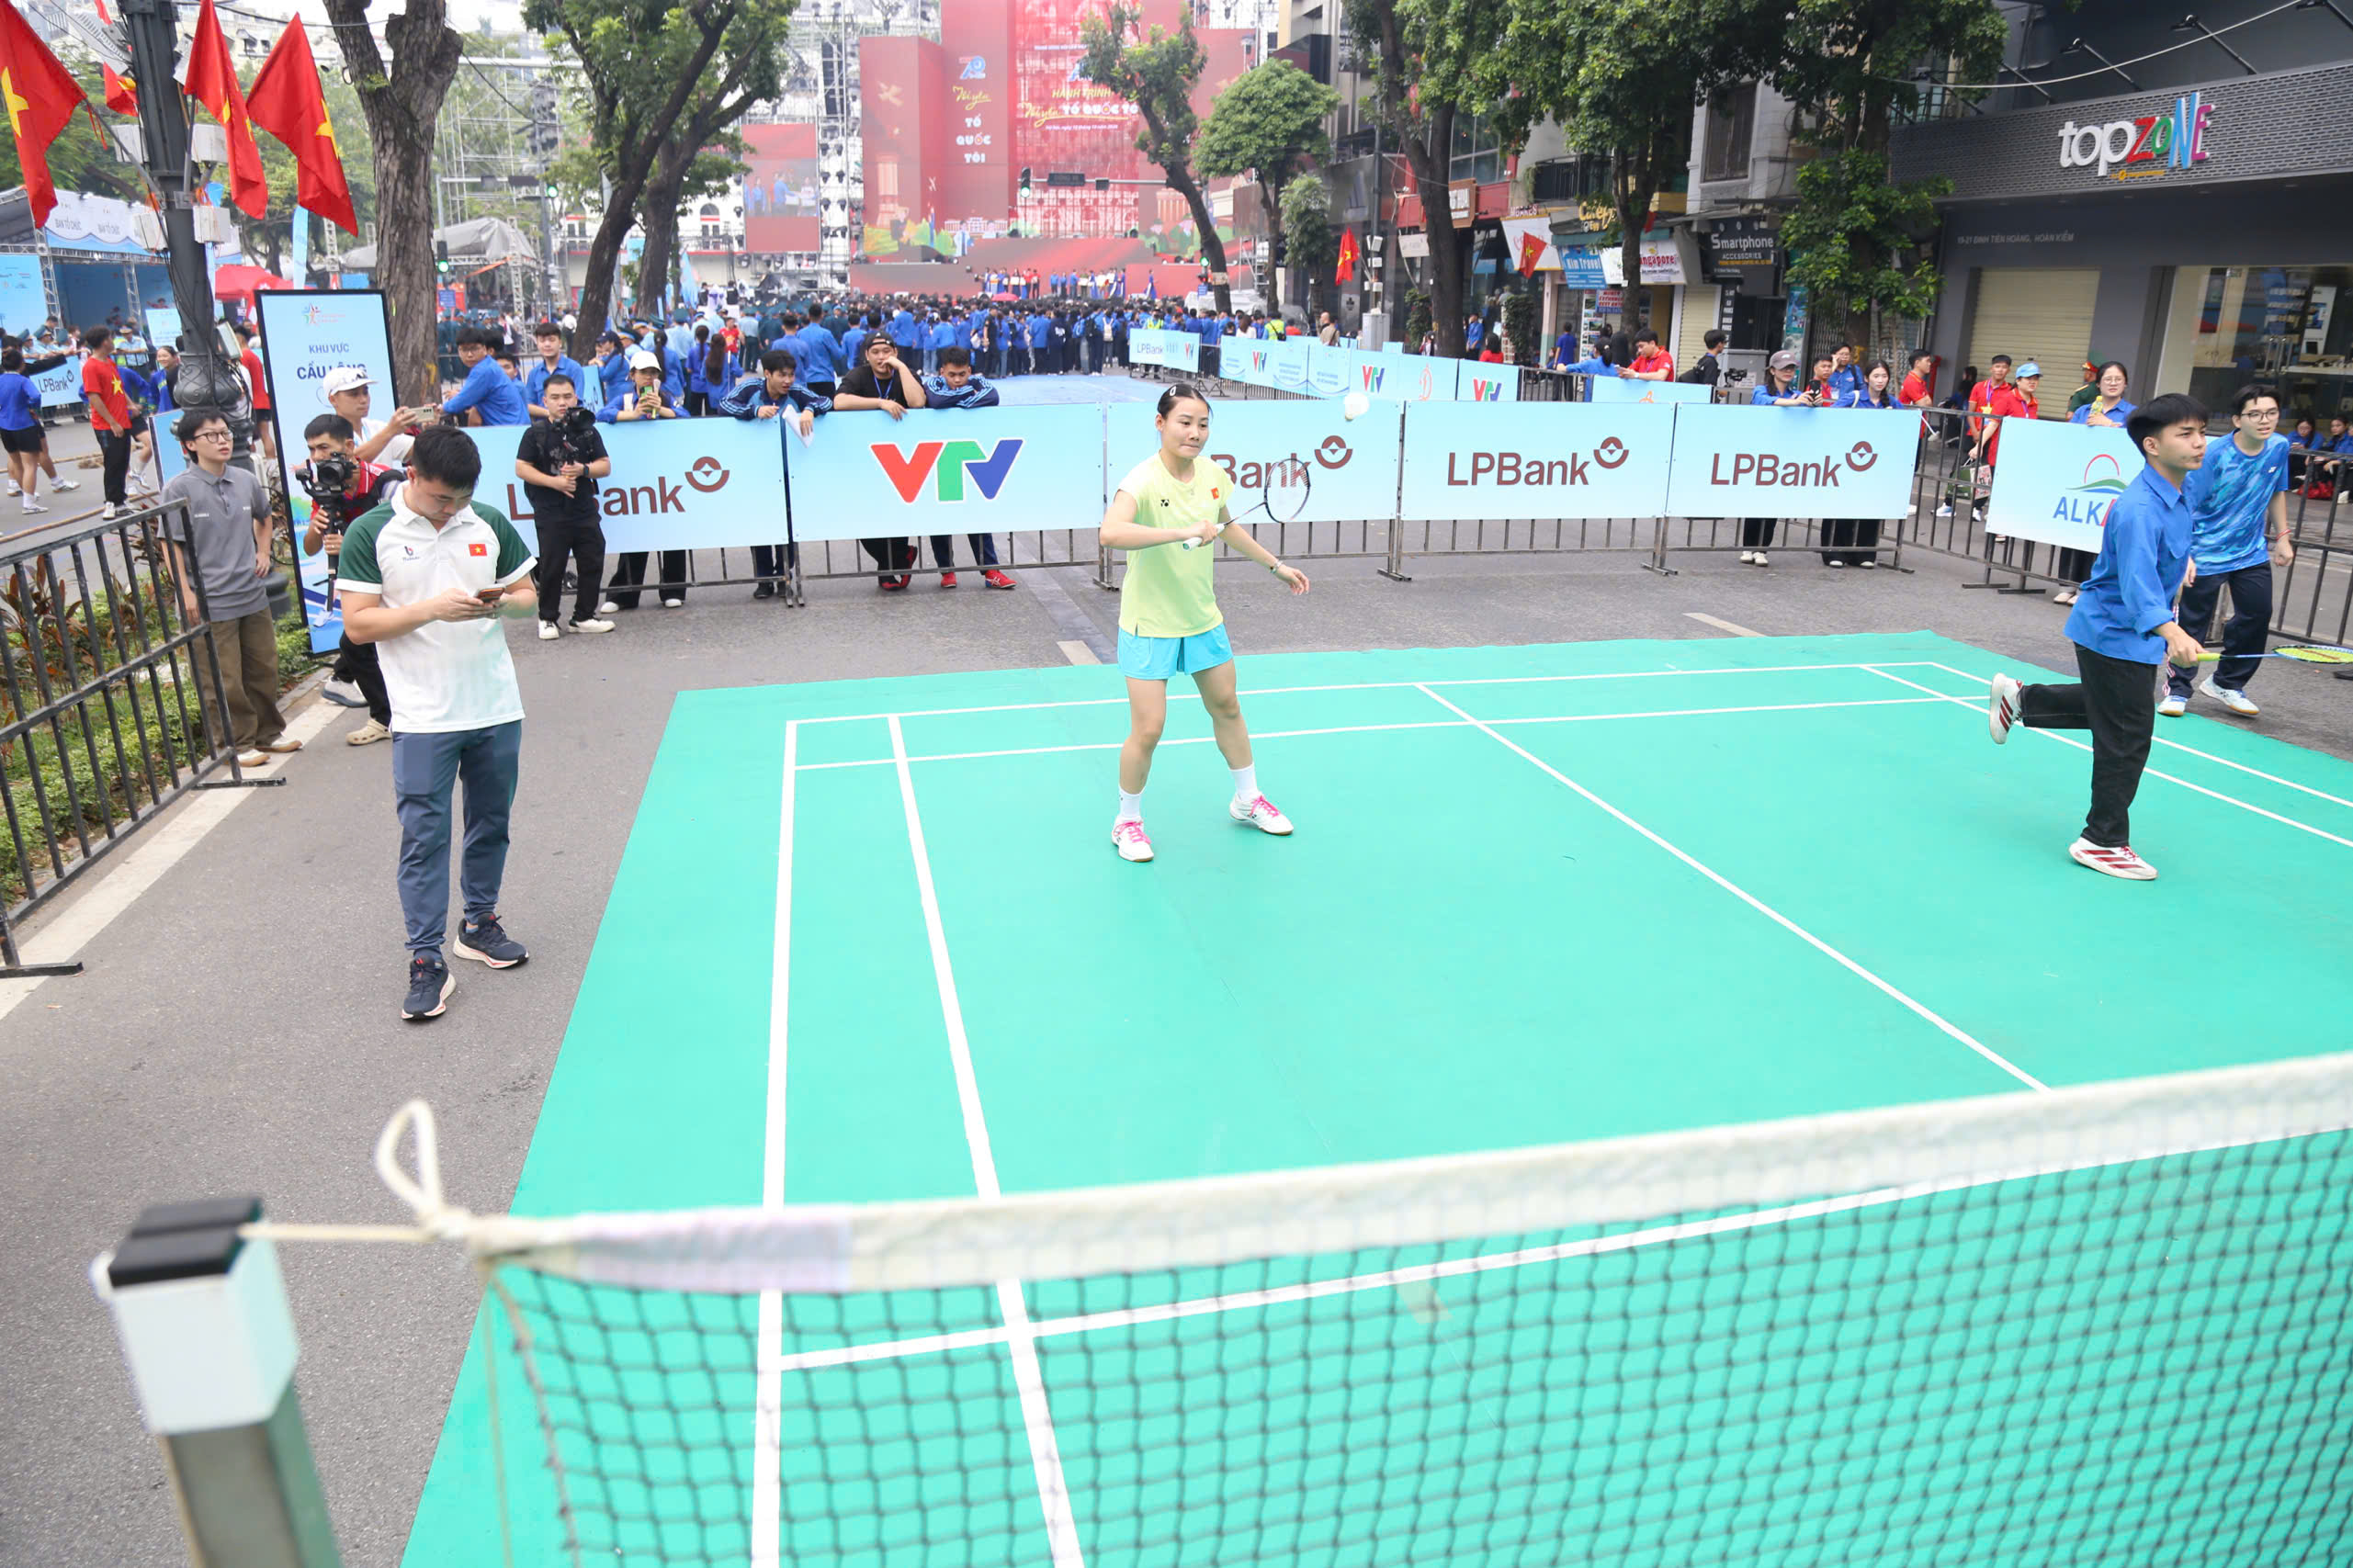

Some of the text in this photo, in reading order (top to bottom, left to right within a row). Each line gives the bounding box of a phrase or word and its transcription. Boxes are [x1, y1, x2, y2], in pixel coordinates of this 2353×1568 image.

[1711, 233, 1774, 251] Smartphone
[309, 344, 329, 354] KHU
[297, 360, 326, 379] CẦU
[38, 376, 69, 393] LPBank
[870, 438, 1024, 504] VTV
[1448, 452, 1589, 487] LPBank
[1712, 454, 1840, 488] LPBank
